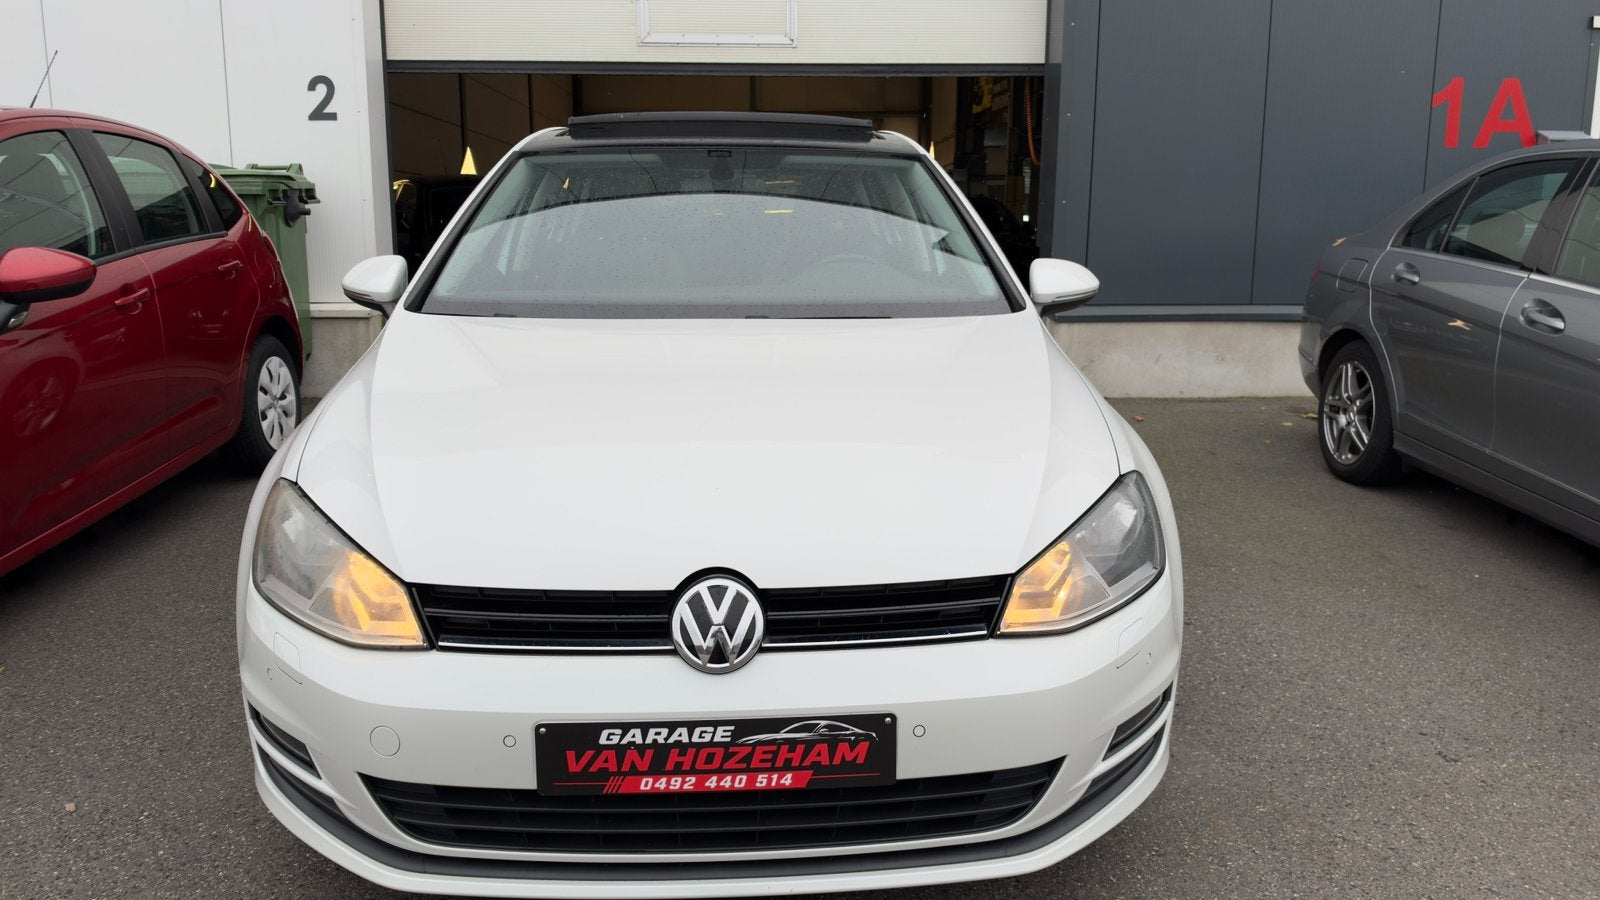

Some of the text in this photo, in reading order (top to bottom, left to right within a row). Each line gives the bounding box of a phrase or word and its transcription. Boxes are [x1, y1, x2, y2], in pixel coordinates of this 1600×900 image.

[307, 74, 338, 121] 2
[1431, 76, 1537, 149] 1A
[674, 579, 762, 669] VW
[598, 725, 735, 745] GARAGE
[566, 741, 870, 772] VAN HOZEHAM
[639, 773, 793, 791] 0492 440 514
